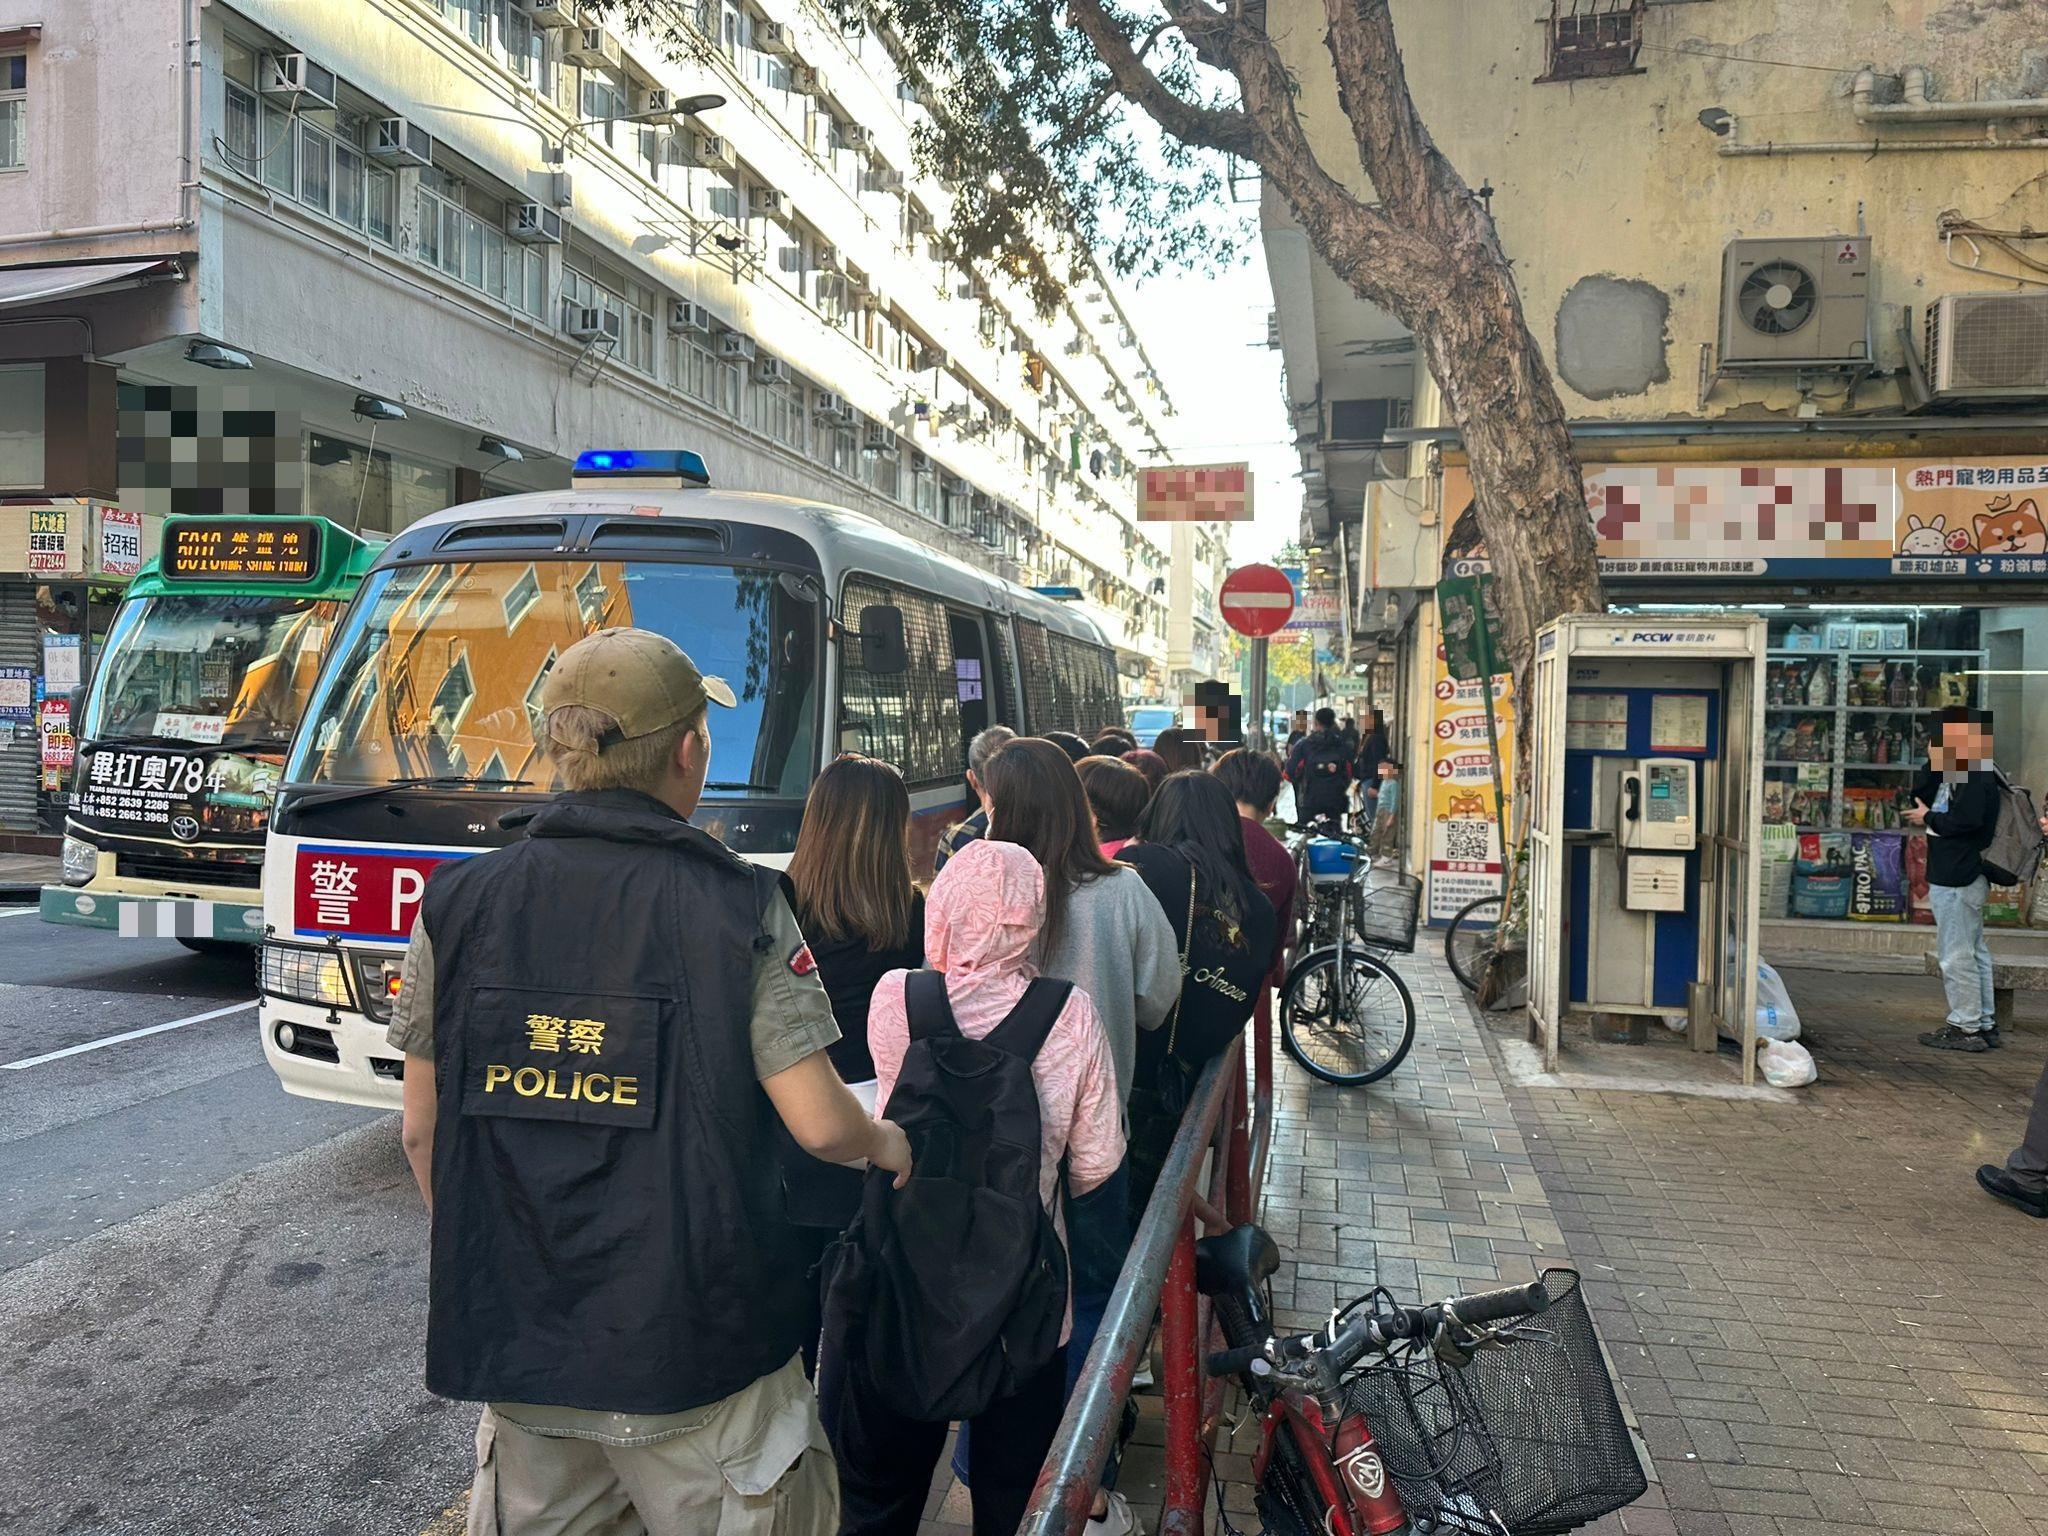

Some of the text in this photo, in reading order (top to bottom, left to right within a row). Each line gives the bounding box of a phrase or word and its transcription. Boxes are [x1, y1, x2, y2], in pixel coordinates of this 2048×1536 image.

[104, 532, 139, 557] 招租
[1632, 632, 1673, 642] PCCW
[43, 722, 66, 734] Call
[48, 735, 74, 751] 即到
[89, 785, 188, 800] YEARS SERVING NEW TERRITORIES
[119, 797, 142, 808] 2639
[144, 799, 170, 811] 2286
[118, 809, 142, 820] 2662
[144, 811, 169, 823] 3968
[309, 859, 359, 926] 警
[525, 1013, 606, 1056] 警察
[485, 1064, 638, 1106] POLICE
